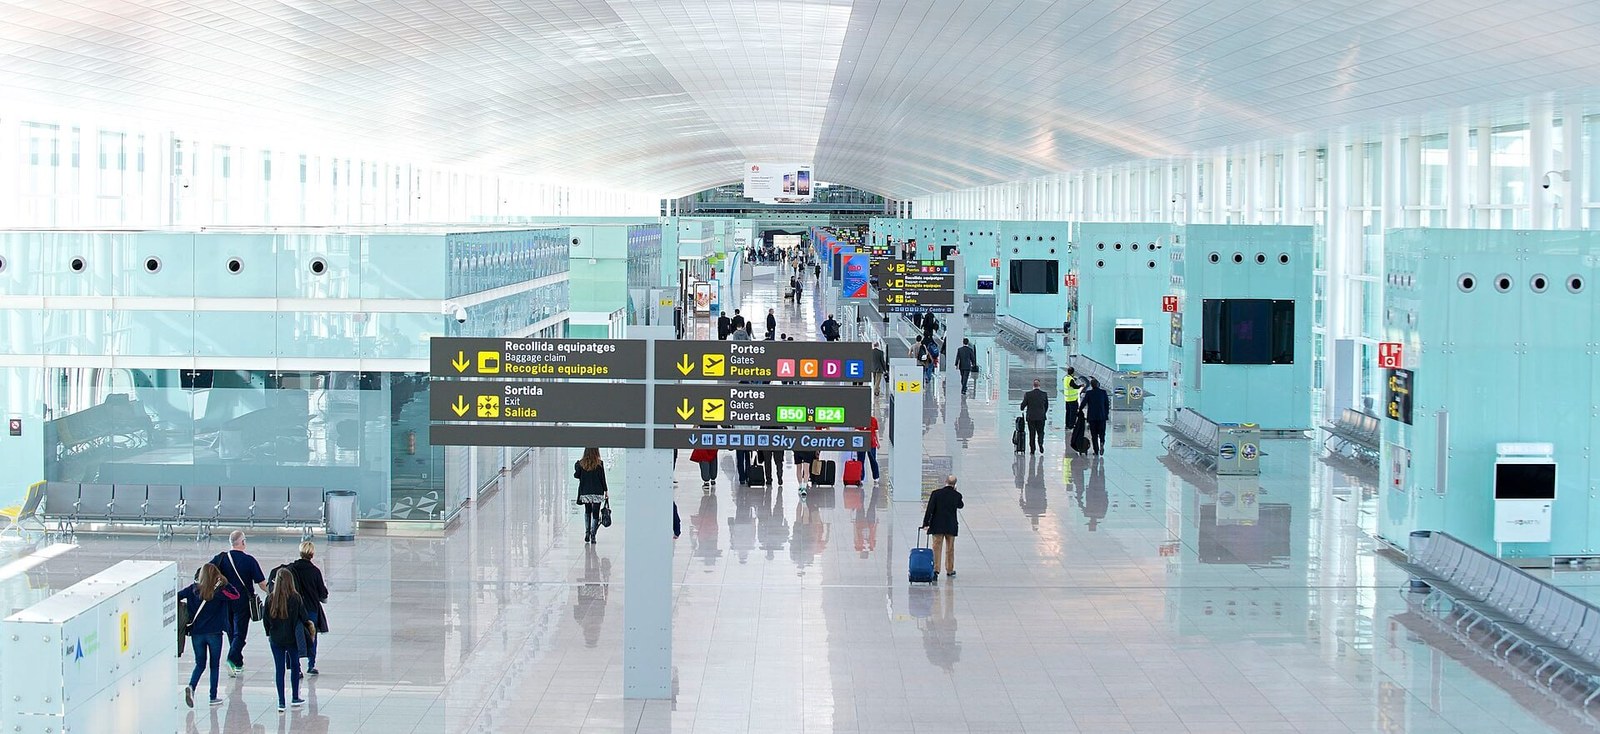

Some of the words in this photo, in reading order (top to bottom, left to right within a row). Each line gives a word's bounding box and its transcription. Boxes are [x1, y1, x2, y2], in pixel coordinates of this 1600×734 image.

[505, 341, 554, 351] Recollida
[557, 342, 616, 353] equipatges
[730, 344, 765, 354] Portes
[505, 353, 542, 363] Baggage
[544, 353, 566, 362] claim
[730, 355, 755, 364] Gates
[505, 363, 554, 374] Recogida
[558, 364, 608, 375] equipajes
[730, 366, 771, 376] Puertas
[781, 362, 791, 374] A
[804, 362, 814, 374] C
[827, 363, 837, 374] D
[850, 363, 859, 374] E
[504, 386, 543, 395] Sortida
[730, 389, 765, 398] Portes
[504, 397, 520, 405] Exit
[730, 400, 754, 409] Gates
[504, 408, 537, 417] Salida
[730, 411, 770, 421] Puertas
[780, 409, 803, 419] B50
[818, 410, 841, 420] B24
[772, 435, 796, 448] Sky
[801, 435, 845, 447] Centre
